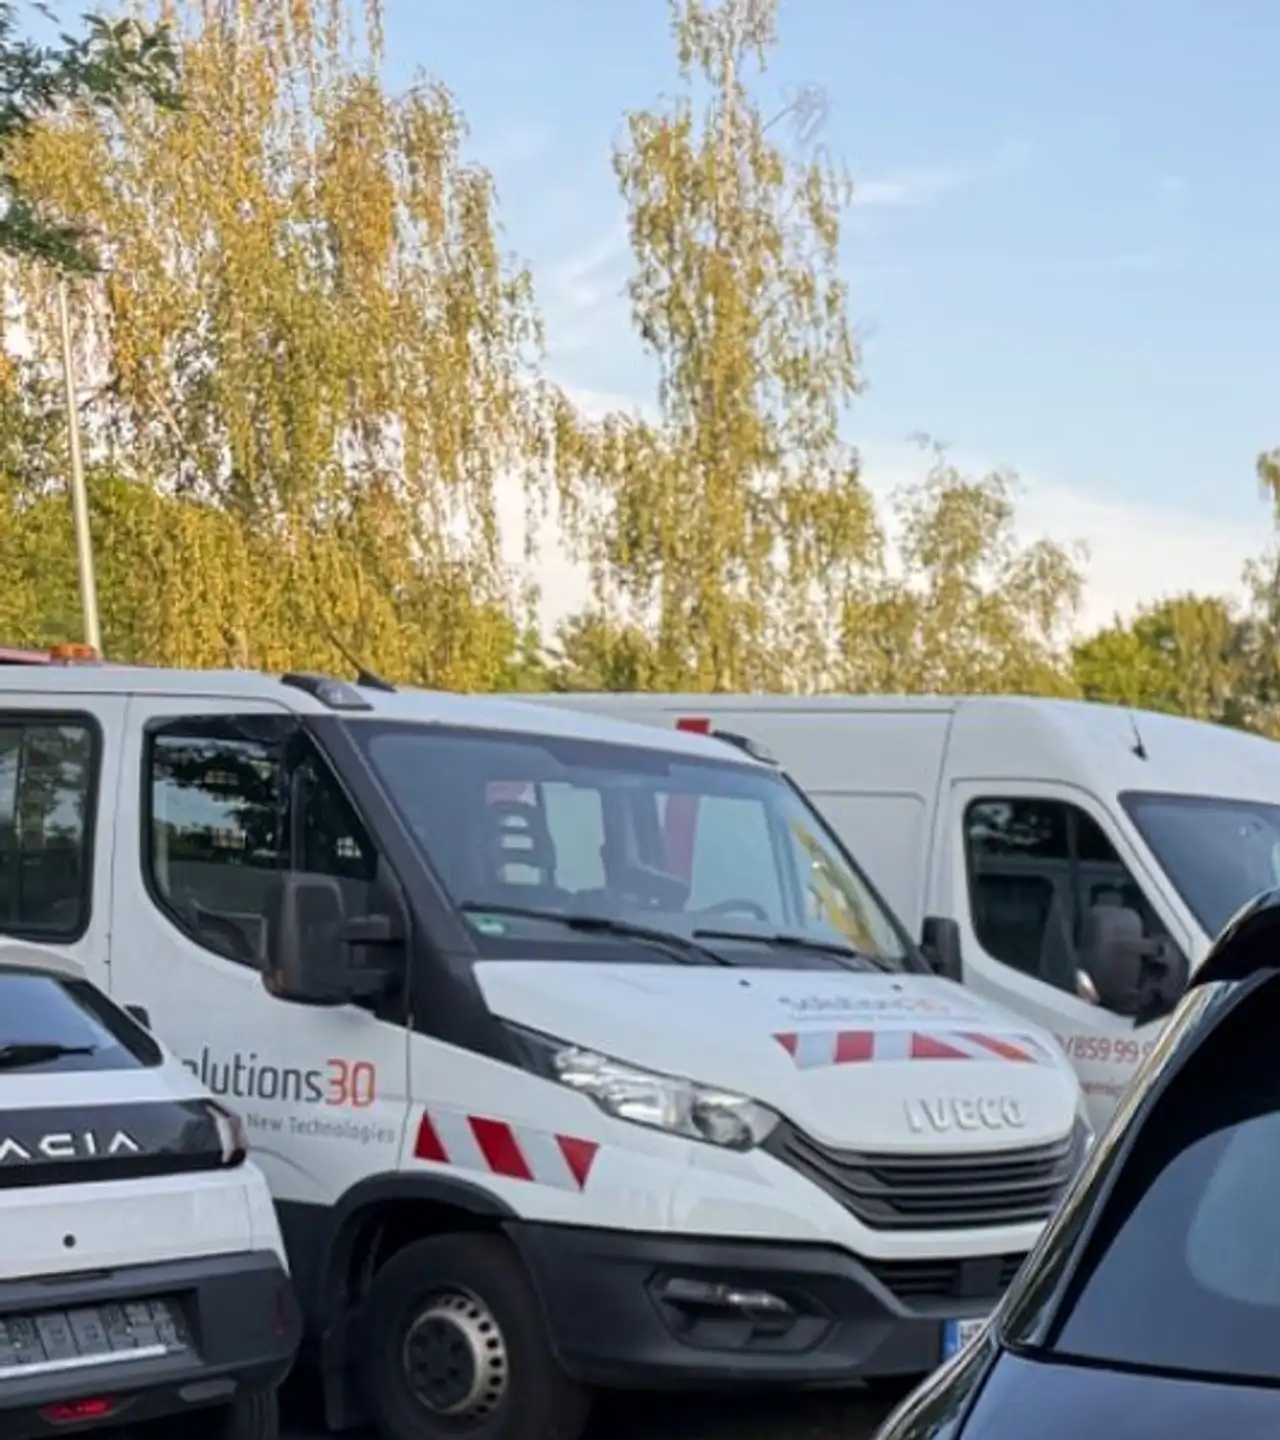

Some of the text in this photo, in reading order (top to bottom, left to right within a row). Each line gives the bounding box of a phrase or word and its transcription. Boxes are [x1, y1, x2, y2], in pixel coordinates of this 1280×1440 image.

[182, 1046, 376, 1107] lutions30
[289, 1117, 396, 1144] Technologies
[904, 1098, 1028, 1133] IVECO
[0, 1131, 139, 1160] ACIA
